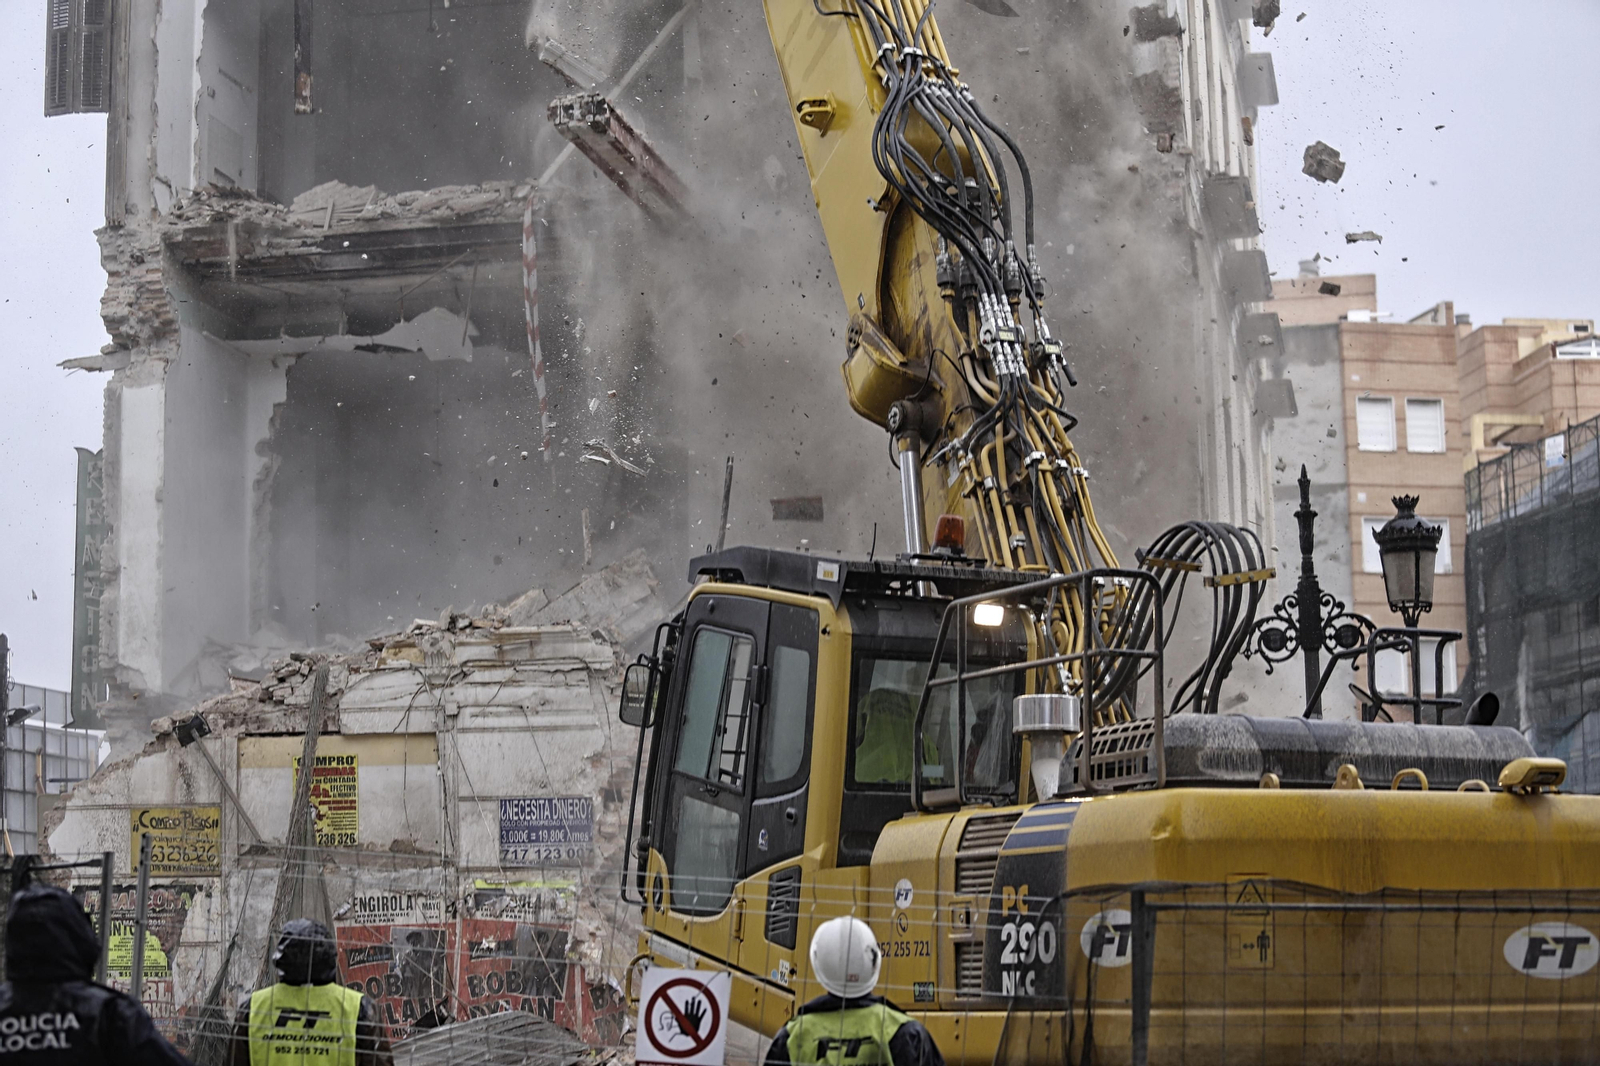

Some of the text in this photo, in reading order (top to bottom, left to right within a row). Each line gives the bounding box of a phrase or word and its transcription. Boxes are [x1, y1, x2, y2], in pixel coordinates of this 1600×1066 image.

[323, 776, 356, 784] CONTADO
[330, 784, 356, 792] EFECTIVO
[501, 800, 550, 820] ¿NECESITA
[318, 833, 355, 845] 236 326
[502, 849, 528, 860] 717
[535, 849, 561, 860] 123
[353, 895, 413, 913] ENGIROLA
[1002, 884, 1029, 917] PC
[877, 941, 931, 958] 52 255 721
[1000, 921, 1056, 965] 290
[1522, 936, 1591, 969] FT
[467, 970, 523, 998] BOB
[0, 1012, 80, 1035] OLICIA
[275, 1046, 330, 1056] 952 255 721
